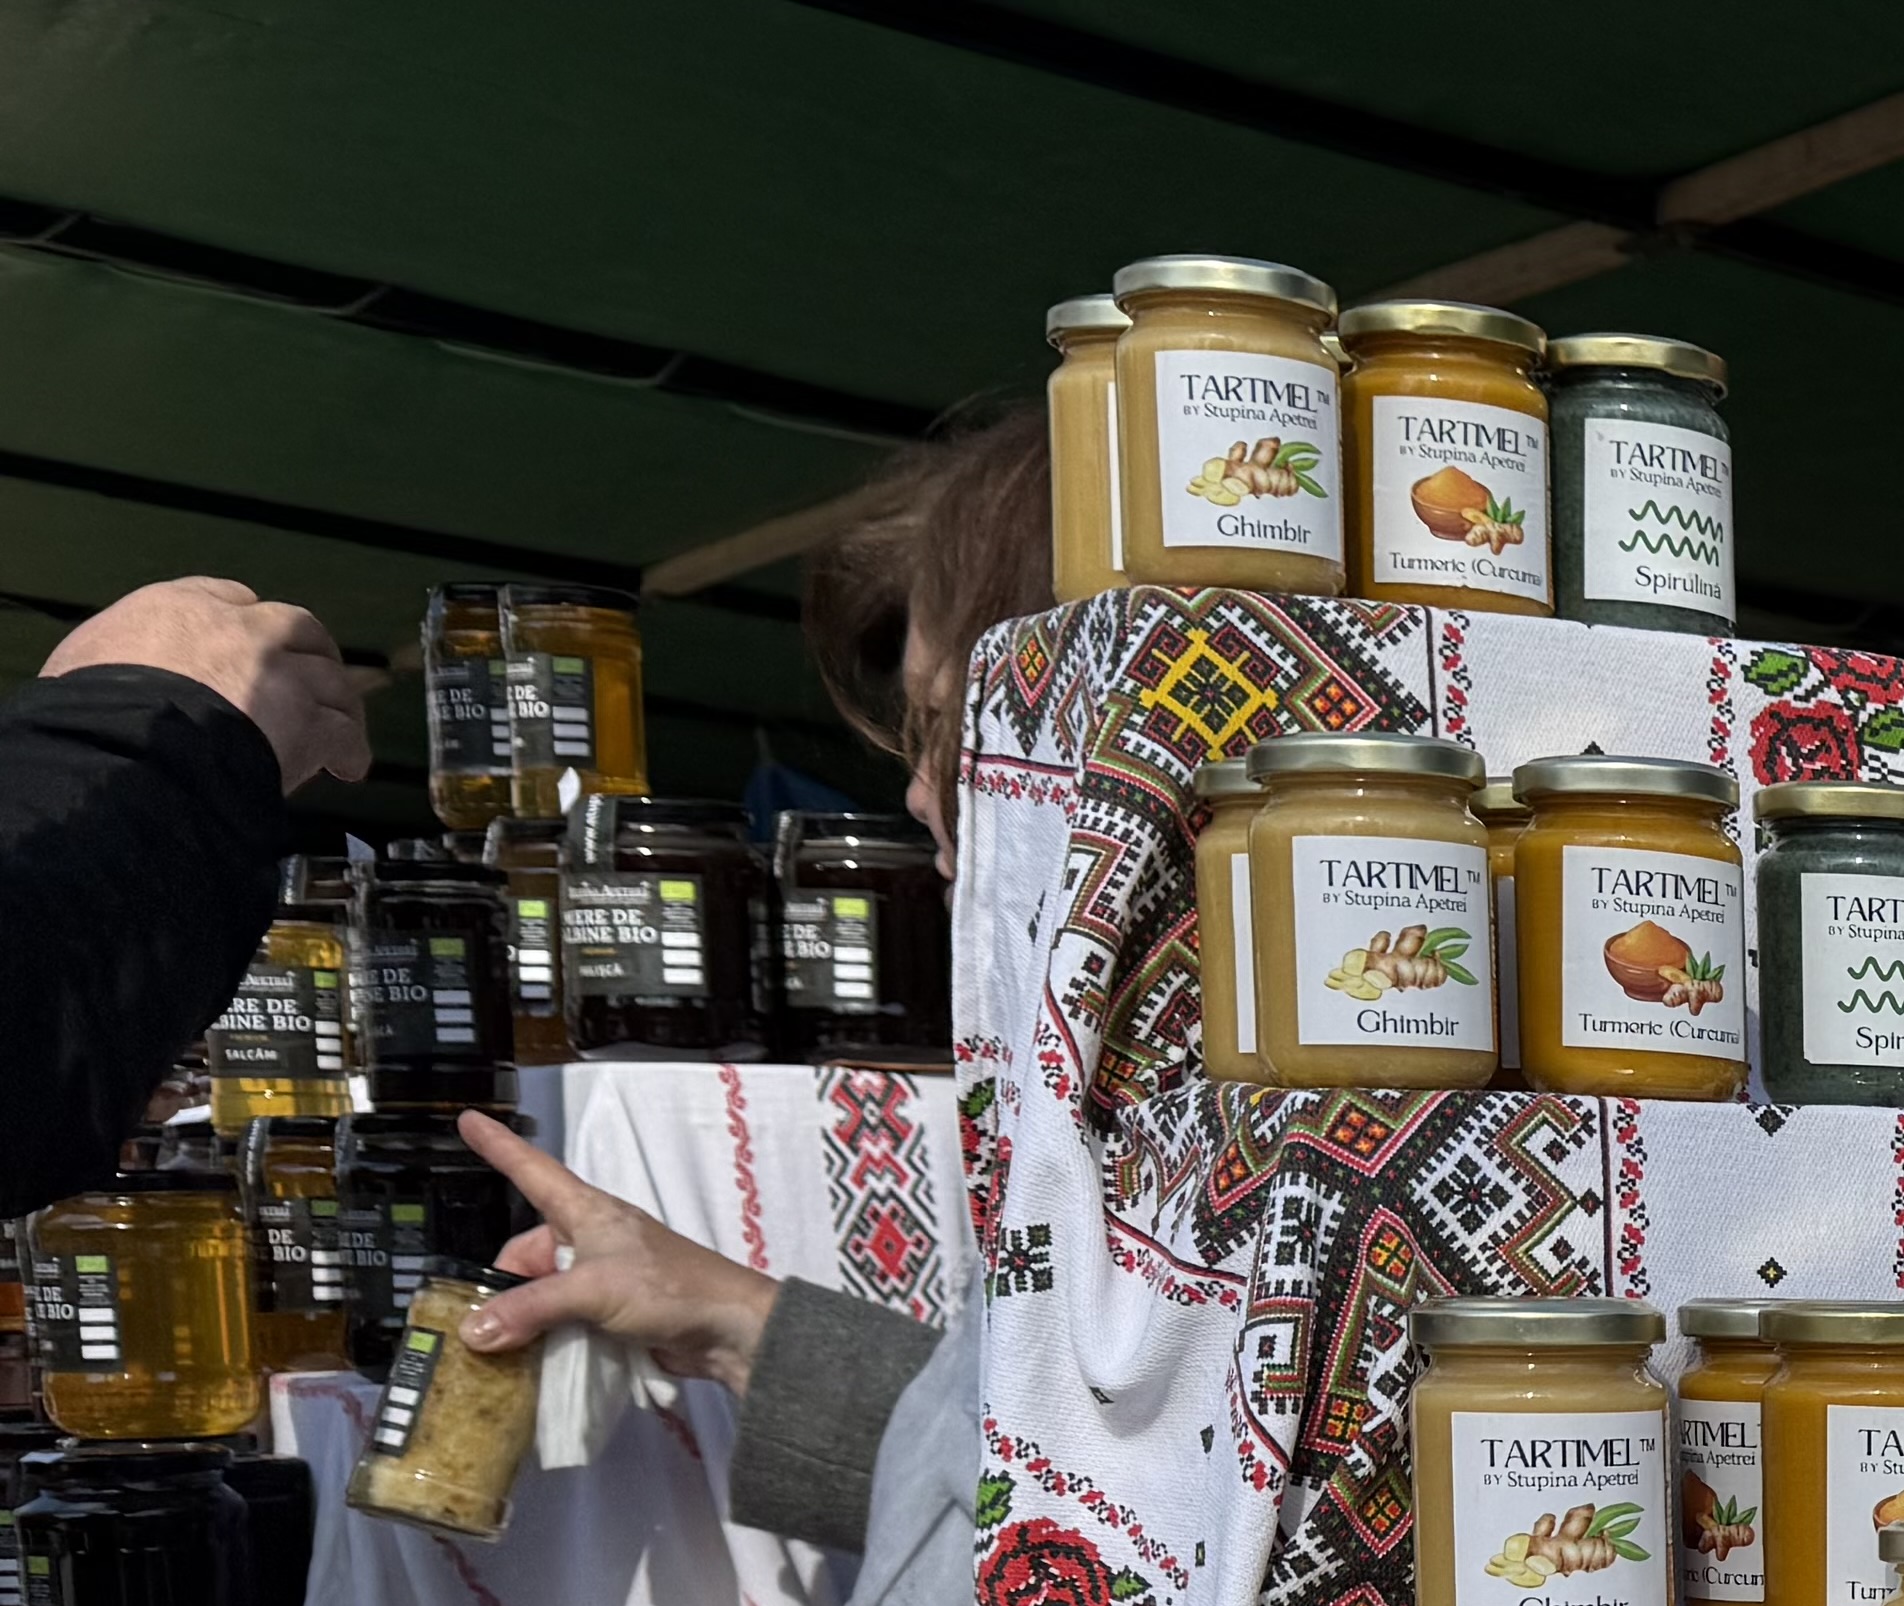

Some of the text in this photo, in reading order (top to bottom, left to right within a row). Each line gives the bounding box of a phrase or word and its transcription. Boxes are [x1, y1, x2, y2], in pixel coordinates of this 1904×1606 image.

[1204, 403, 1265, 423] Stupina
[1419, 442, 1475, 463] Stupina
[1631, 468, 1685, 490] Stupina
[1218, 514, 1311, 544] Ghimbir
[1390, 551, 1466, 573] Turmeric
[1344, 890, 1467, 914] Stupina Apetrei
[1612, 898, 1724, 924] Stupina Apetrei
[273, 1015, 311, 1031] BIO
[1358, 1010, 1460, 1036] Ghimbir
[1579, 1013, 1663, 1036] Turmeric
[1706, 1451, 1755, 1466] Apetrei
[1484, 1470, 1639, 1490] BY Stupina Apetrei
